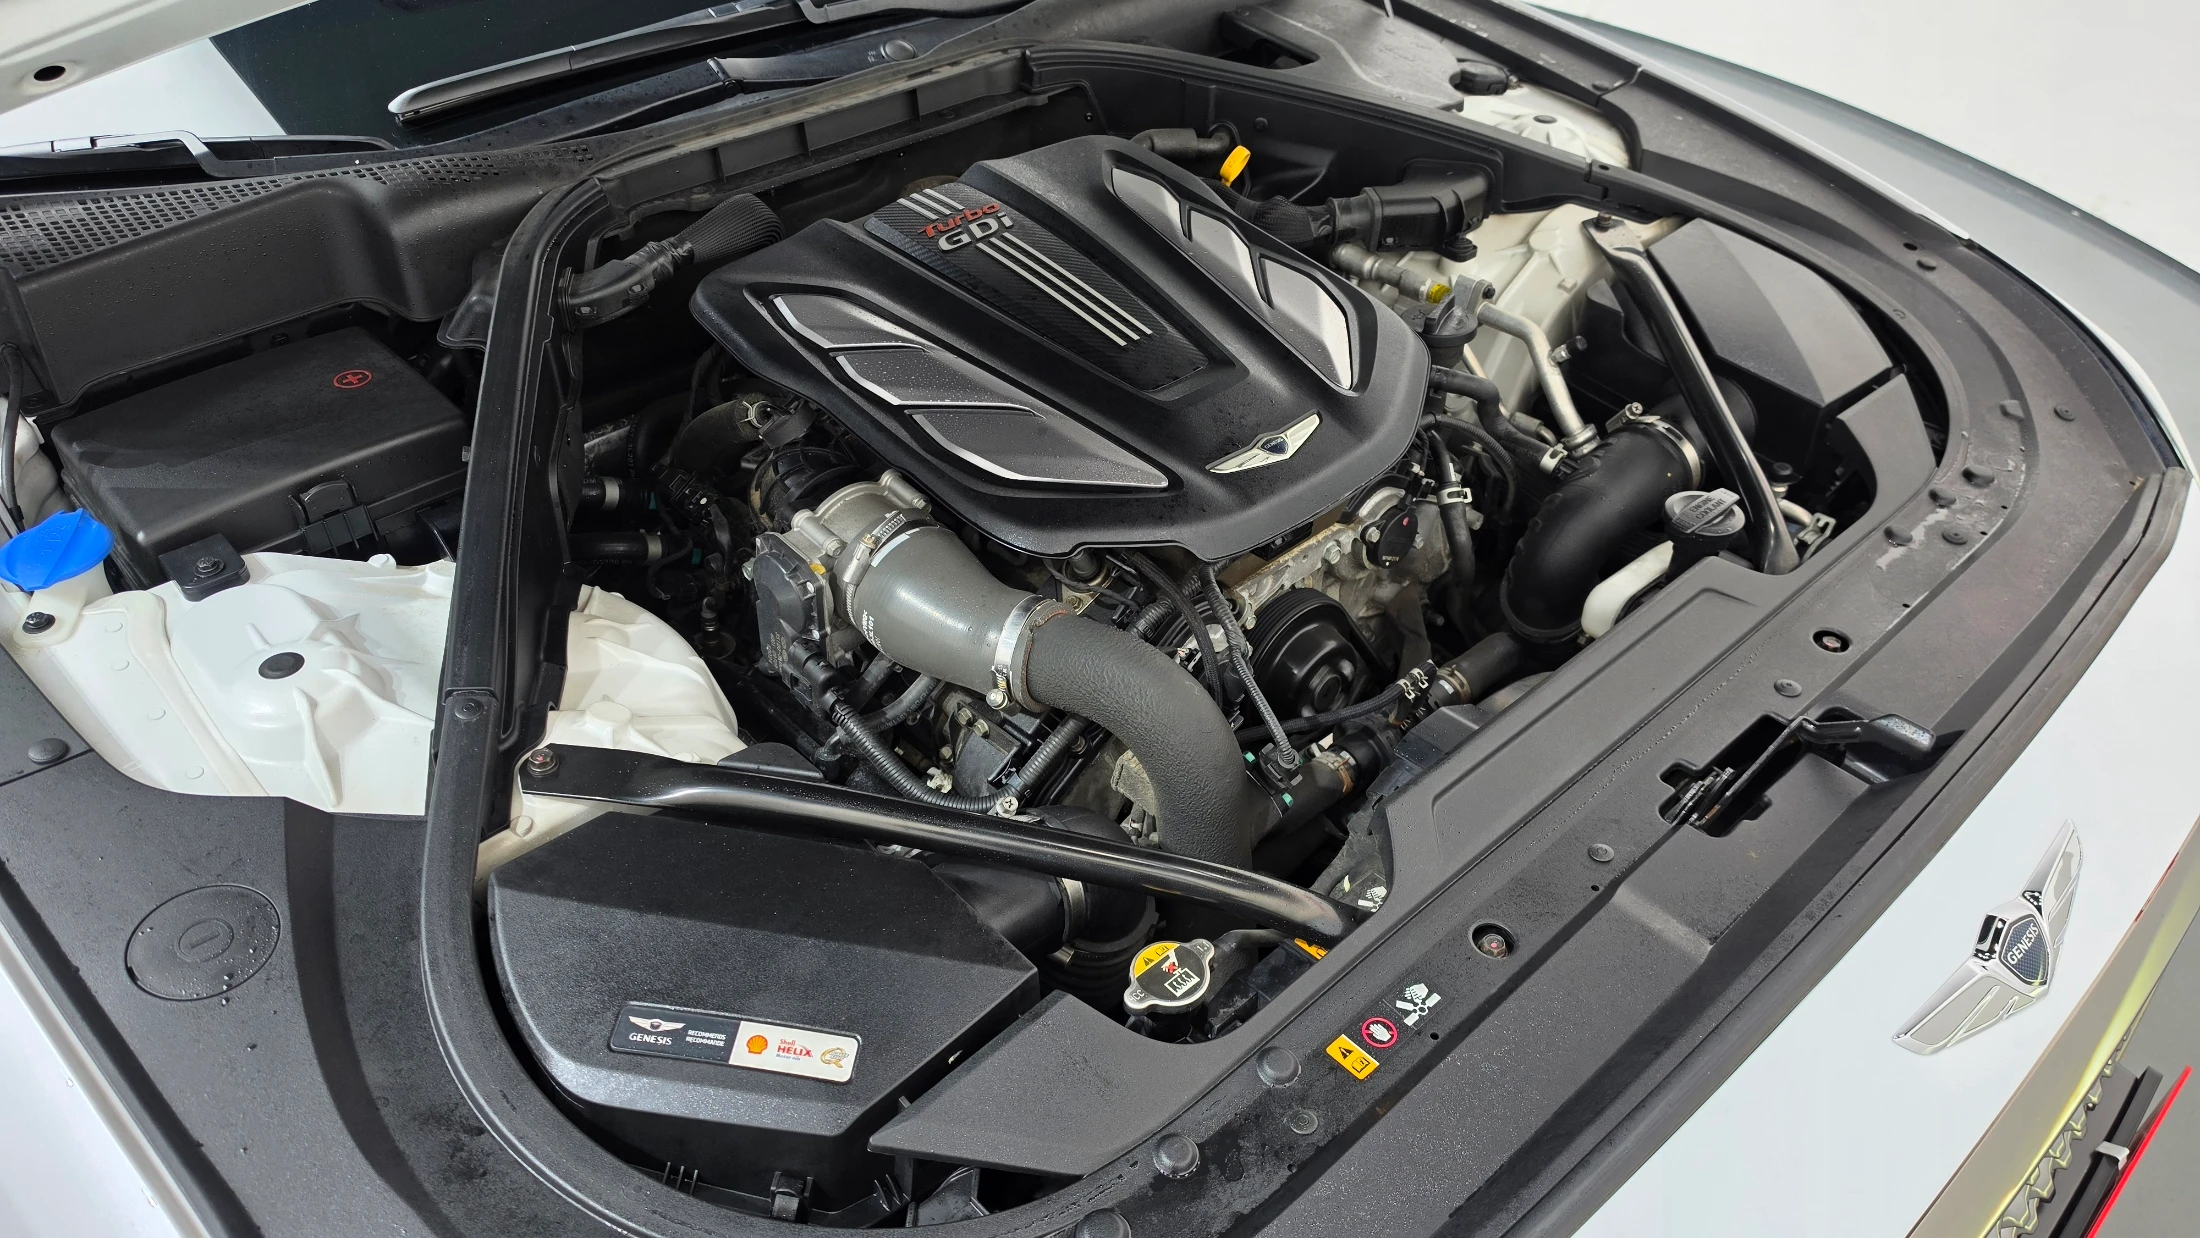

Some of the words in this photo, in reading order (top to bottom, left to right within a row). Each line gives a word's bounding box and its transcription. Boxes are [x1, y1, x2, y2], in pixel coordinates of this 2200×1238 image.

[917, 202, 1001, 238] Turbo
[937, 211, 1014, 251] GDi
[1689, 495, 1716, 512] ENGINE
[1696, 498, 1726, 519] COOLANT
[2007, 923, 2039, 965] GENESIS
[628, 1032, 672, 1046] GENESIS
[687, 1029, 727, 1041] RECOMMENDS
[779, 1038, 796, 1047] Shell
[776, 1045, 813, 1058] HELIX
